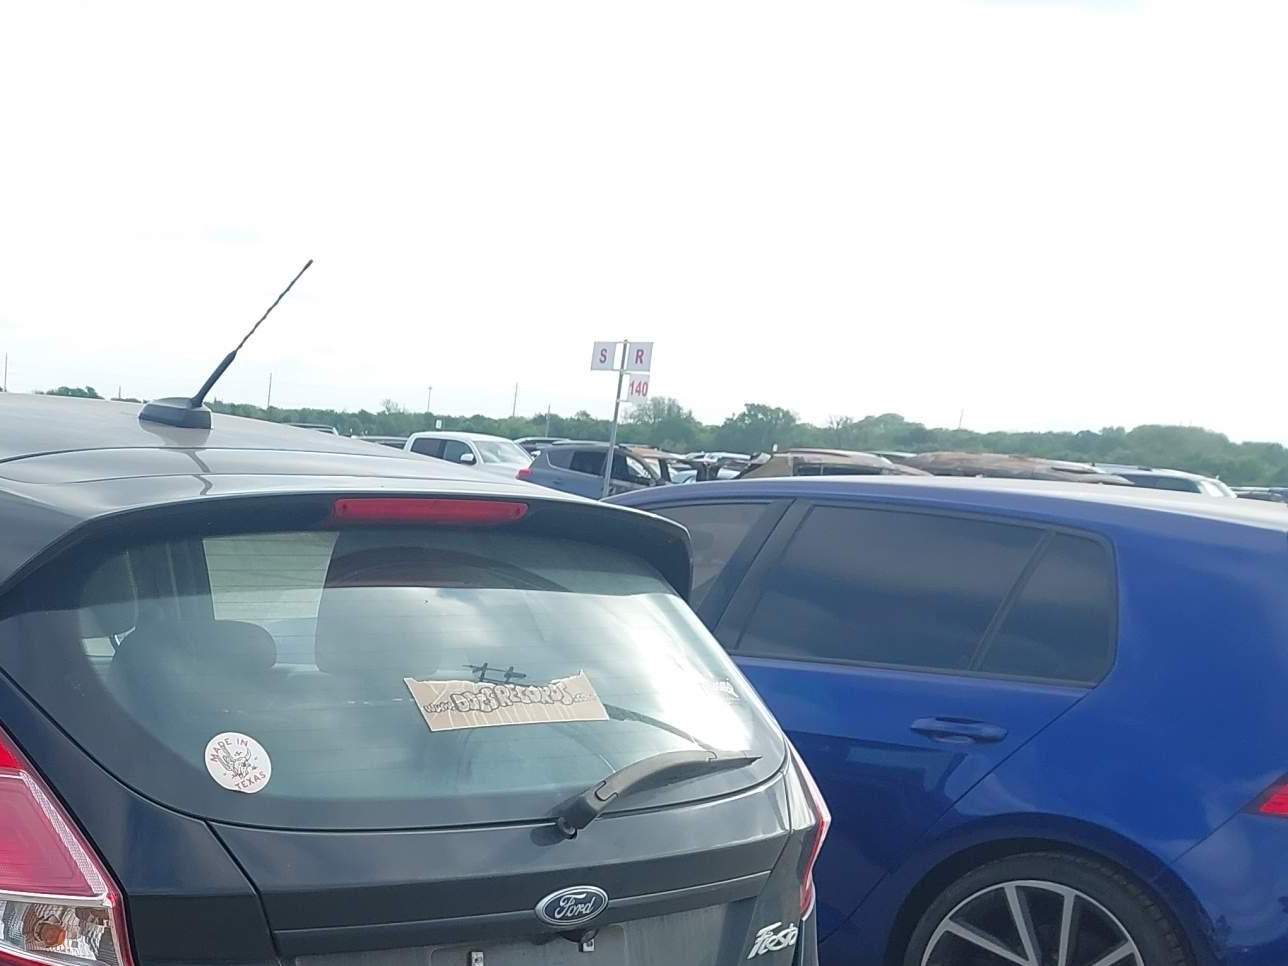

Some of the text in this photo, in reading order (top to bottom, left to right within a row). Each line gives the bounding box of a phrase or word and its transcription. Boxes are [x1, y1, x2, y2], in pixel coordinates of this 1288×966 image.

[599, 348, 608, 364] S
[635, 349, 645, 365] R
[629, 381, 649, 397] 140
[209, 737, 249, 763] MADE IN
[234, 770, 267, 790] TEXAS
[554, 893, 596, 919] Ford
